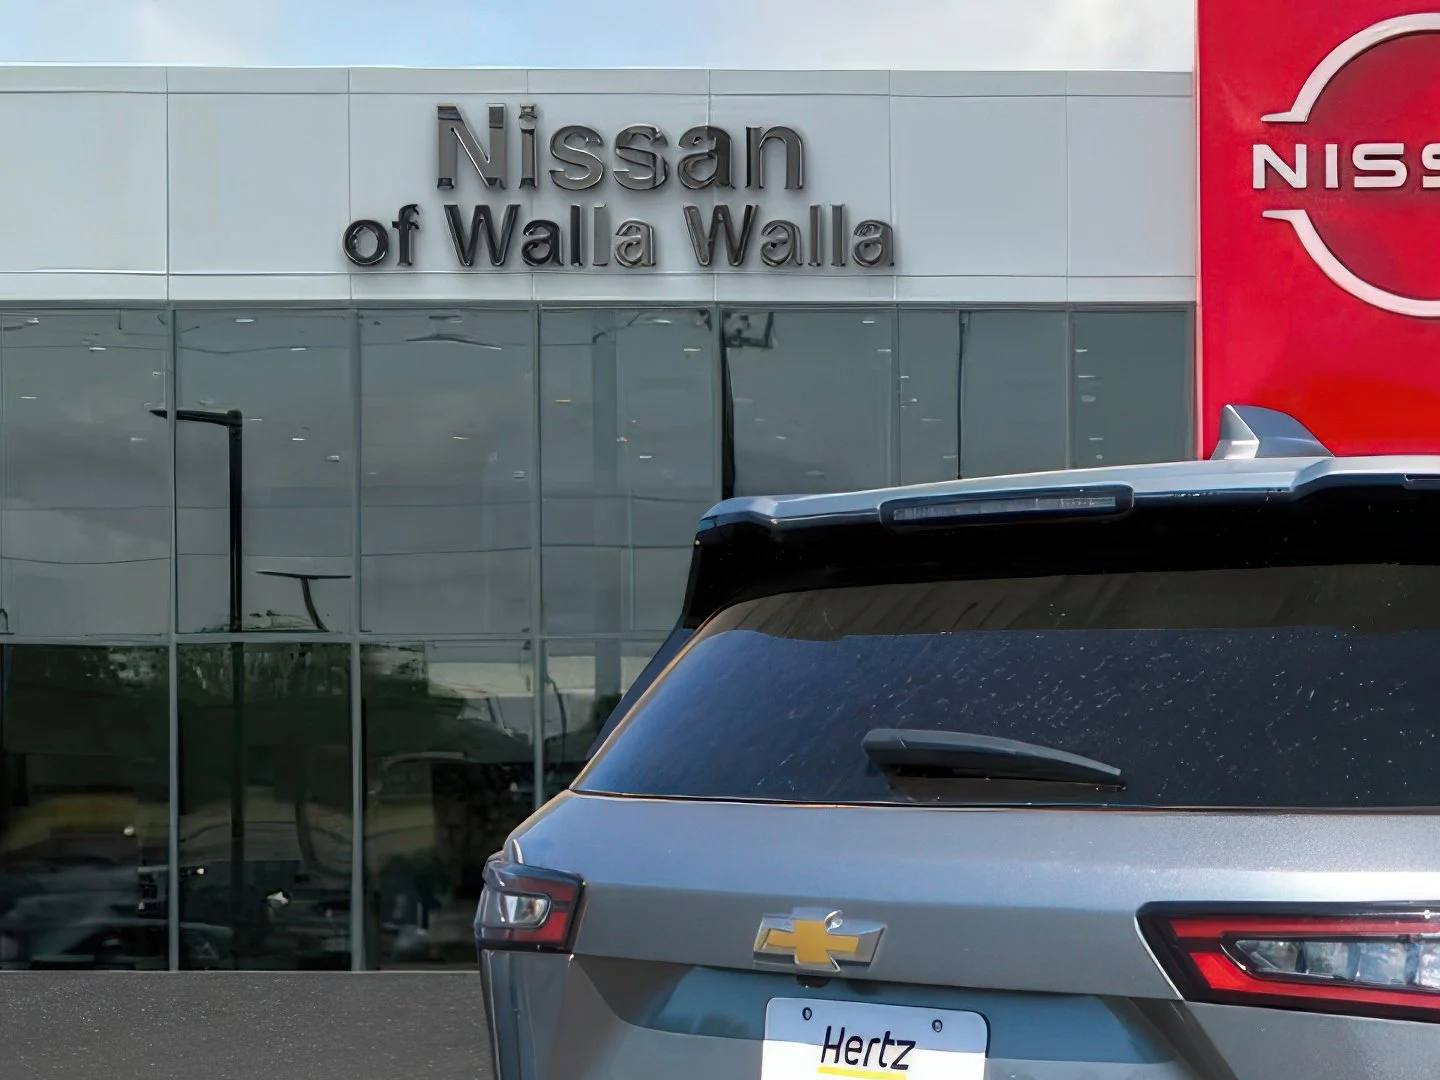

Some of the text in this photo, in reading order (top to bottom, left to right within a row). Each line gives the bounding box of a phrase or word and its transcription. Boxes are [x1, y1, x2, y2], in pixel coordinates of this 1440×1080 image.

[436, 103, 805, 190] Nissan
[343, 203, 895, 267] of Walla Walla
[821, 1025, 916, 1070] Hertz
